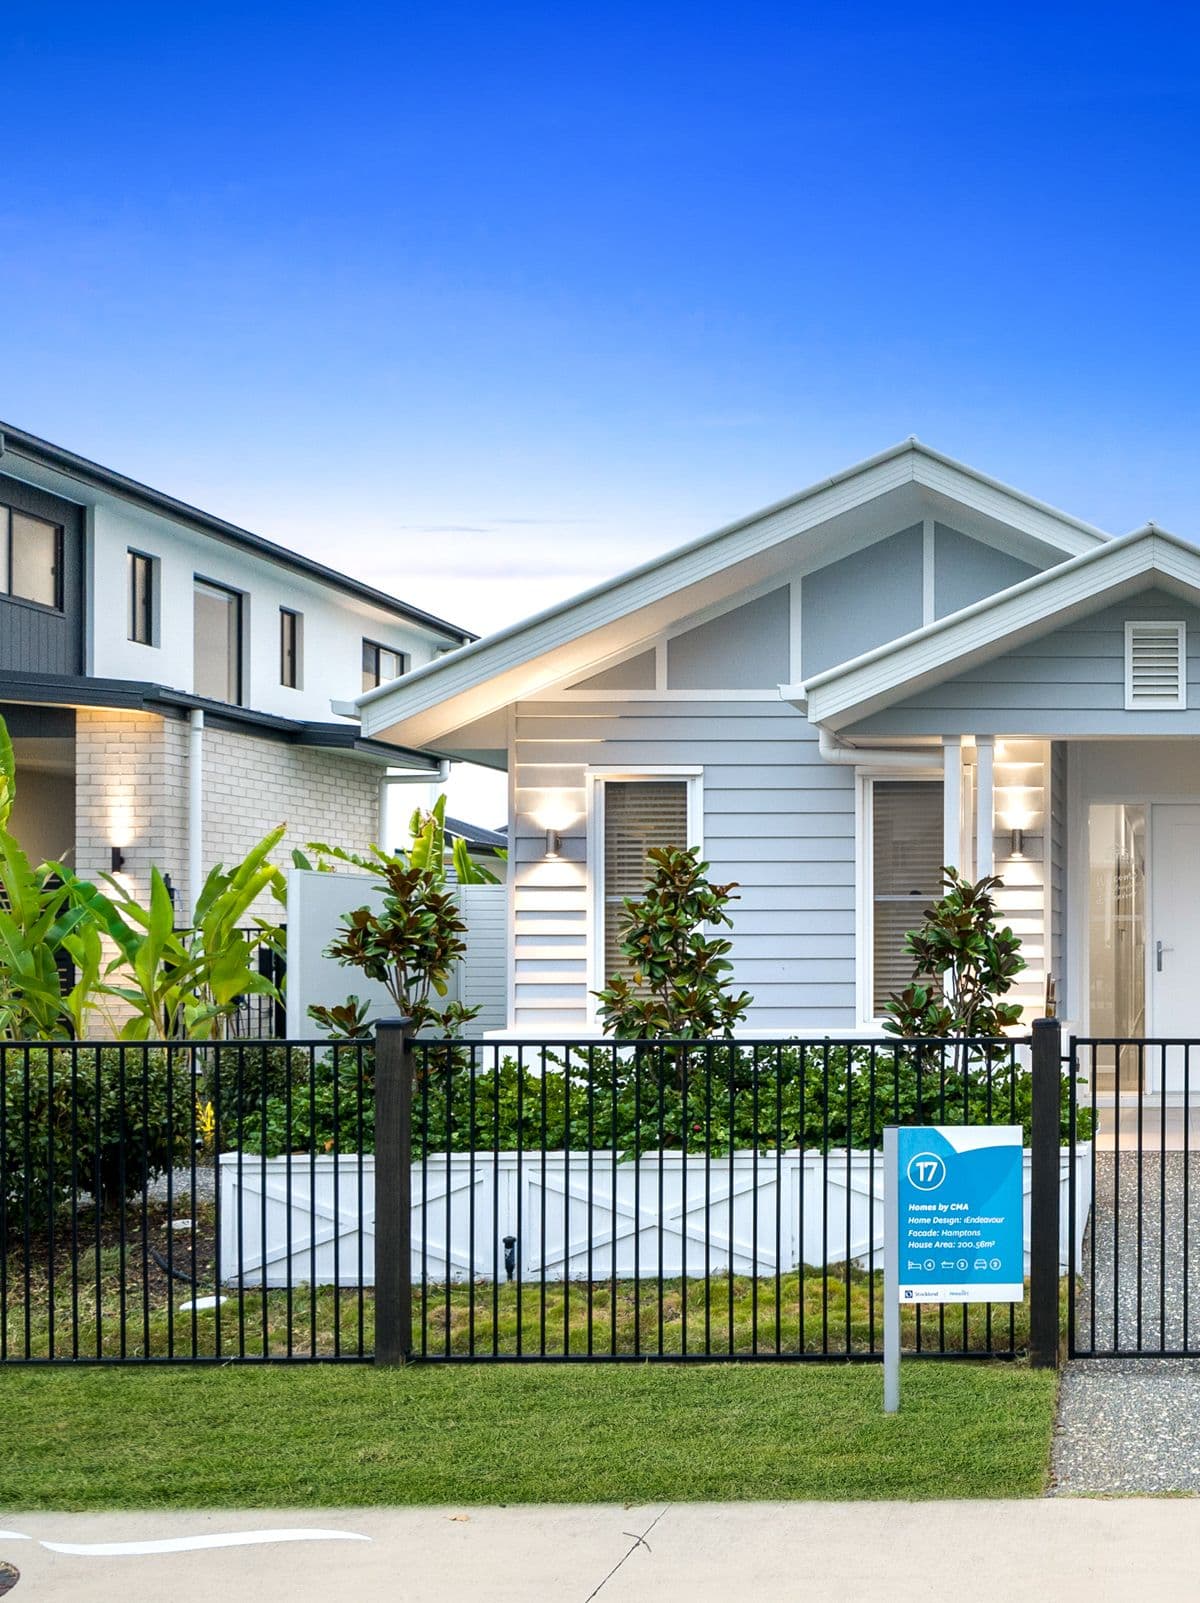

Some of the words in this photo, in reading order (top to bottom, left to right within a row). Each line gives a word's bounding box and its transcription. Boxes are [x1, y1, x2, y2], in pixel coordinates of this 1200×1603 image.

[916, 1161, 938, 1182] 17
[908, 1203, 937, 1211] Homes
[938, 1203, 949, 1212] by
[950, 1203, 969, 1211] CMA
[908, 1216, 931, 1224] Home
[932, 1216, 962, 1225] Design:
[908, 1229, 940, 1237] Facade:
[941, 1229, 981, 1238] Hamptons
